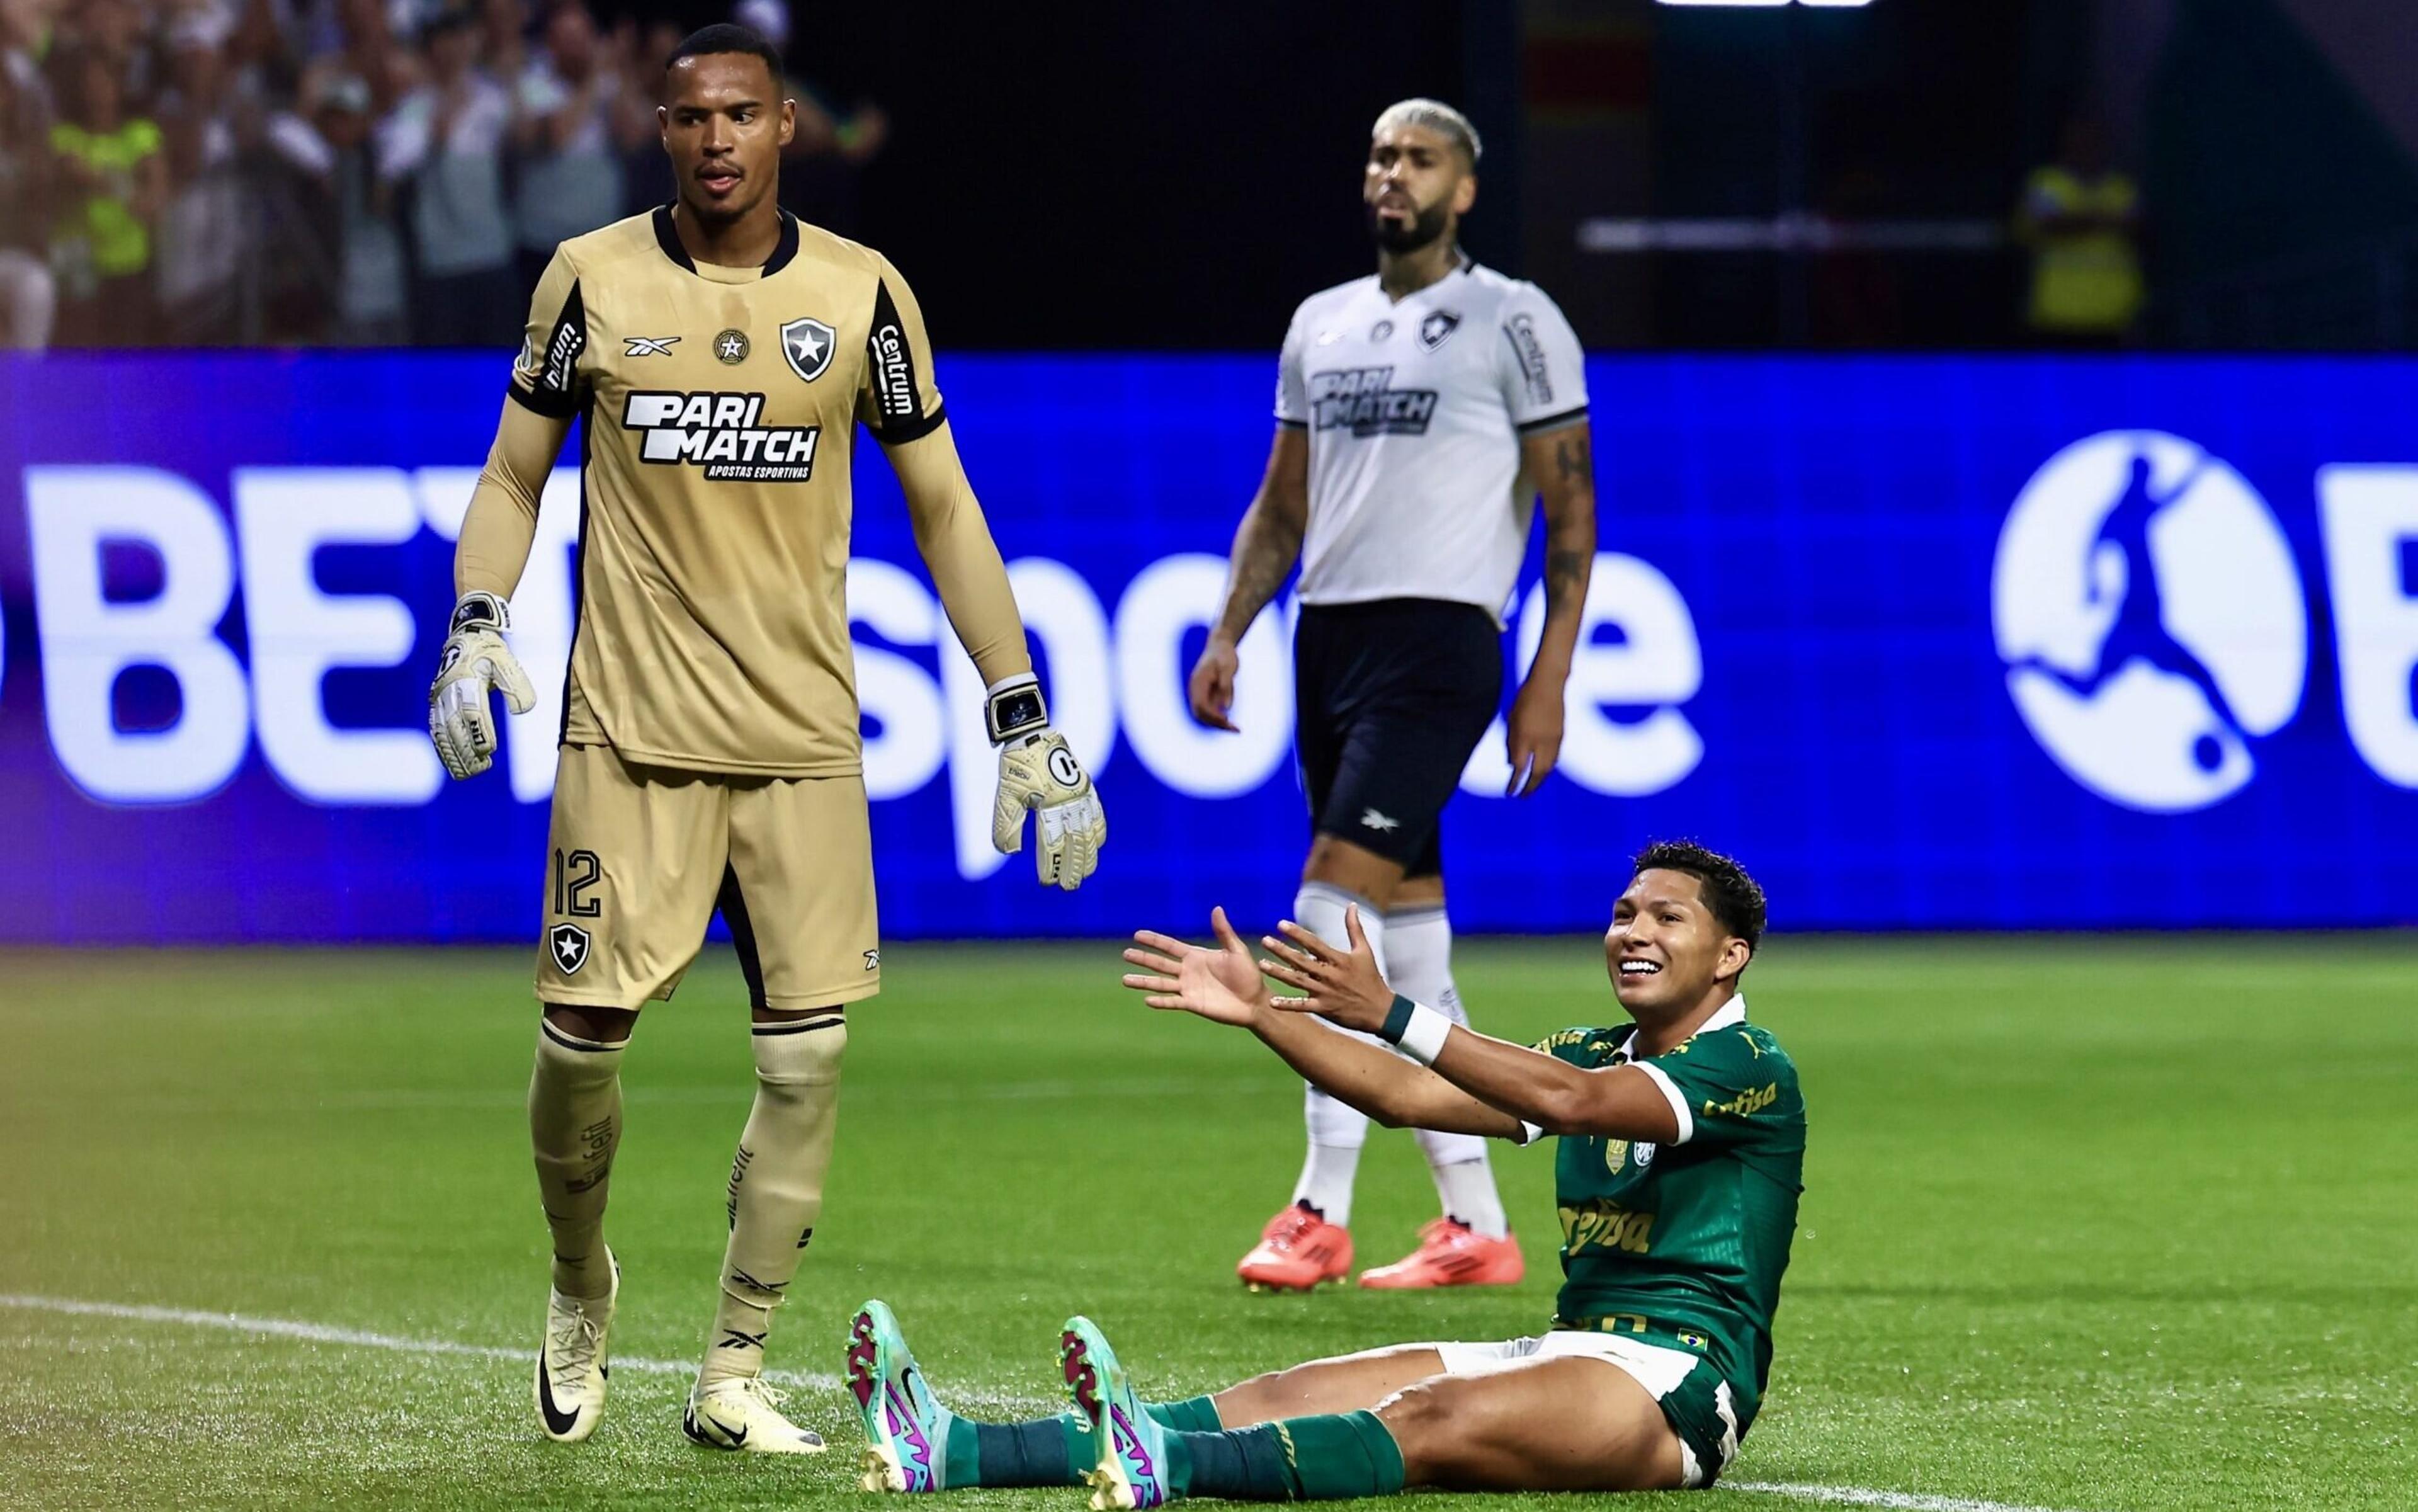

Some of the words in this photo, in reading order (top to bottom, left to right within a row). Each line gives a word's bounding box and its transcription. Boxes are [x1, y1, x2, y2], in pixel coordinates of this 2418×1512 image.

[879, 325, 913, 414] Centrum
[626, 395, 761, 428] PARI
[644, 429, 817, 462] MATCH
[708, 465, 753, 477] APOSTAS
[754, 467, 809, 479] ESPORTIVAS
[555, 848, 601, 918] 12
